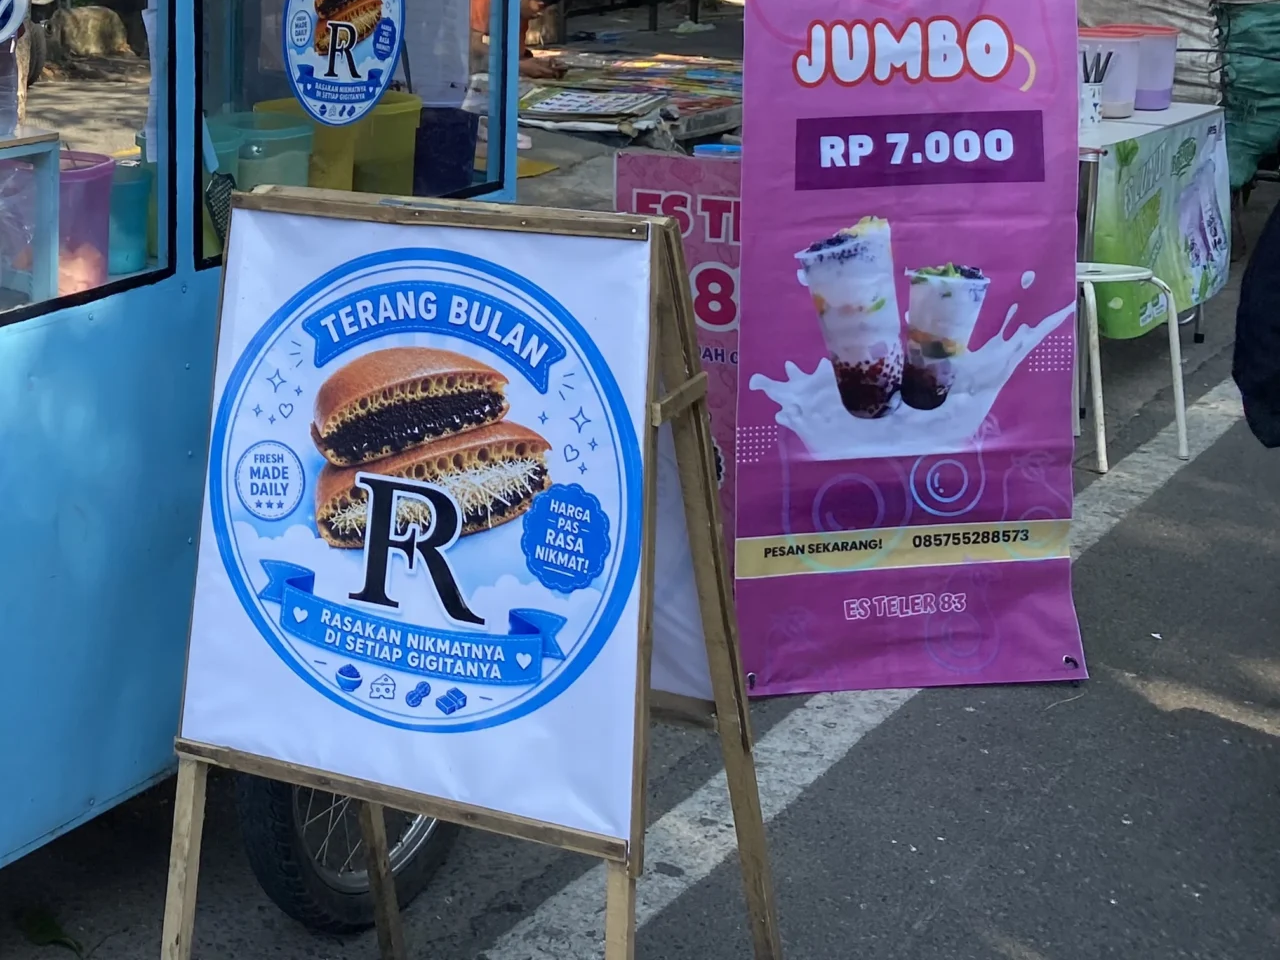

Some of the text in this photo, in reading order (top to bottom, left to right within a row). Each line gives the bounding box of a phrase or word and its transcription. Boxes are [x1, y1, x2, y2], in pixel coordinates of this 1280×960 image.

[792, 15, 1014, 88] JUMBO
[820, 128, 1014, 168] RP 7.000
[320, 290, 549, 368] TERANG BULAN
[254, 453, 284, 464] FRESH
[249, 466, 289, 480] MADE
[250, 482, 289, 496] DAILY
[550, 499, 591, 523] HARGA
[557, 517, 579, 534] PAS
[545, 528, 584, 554] RASA
[763, 529, 1029, 558] PESAN SEKARANG! 085755288573
[535, 544, 590, 573] NIKMAT!
[844, 593, 966, 620] ES TELER 83
[320, 609, 505, 662] RASAKAN NIKMATNYA
[325, 628, 502, 680] DI SETIAP GIGITANYA
